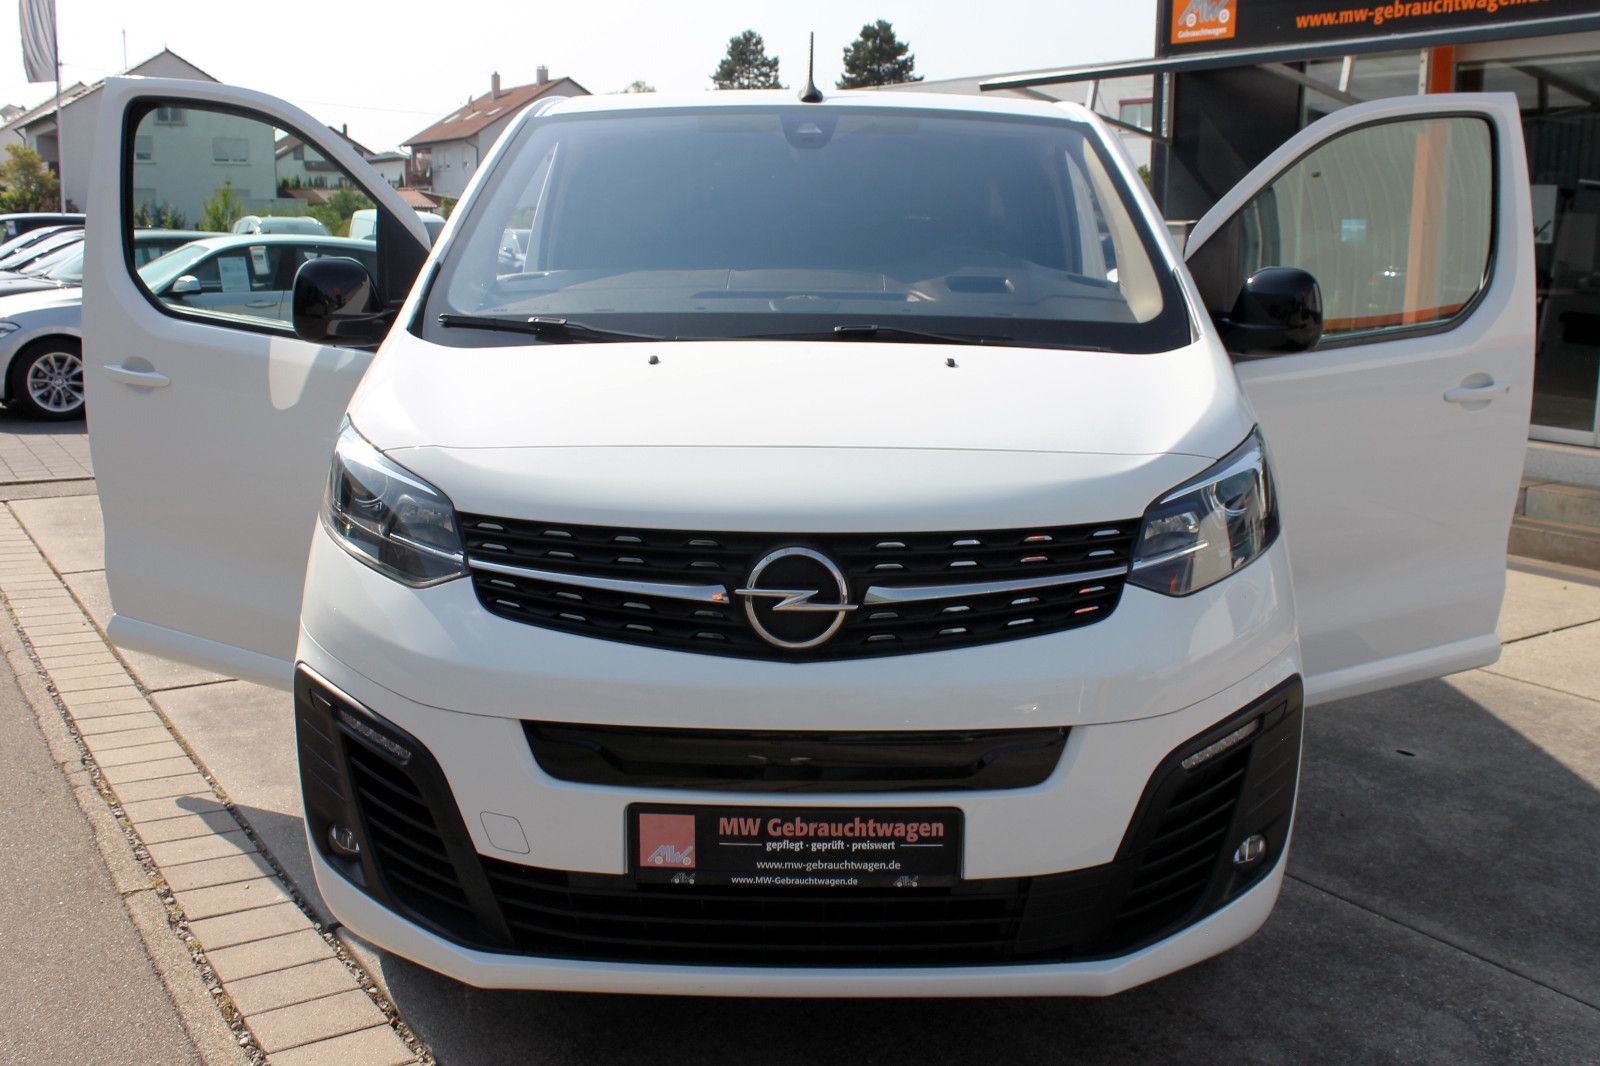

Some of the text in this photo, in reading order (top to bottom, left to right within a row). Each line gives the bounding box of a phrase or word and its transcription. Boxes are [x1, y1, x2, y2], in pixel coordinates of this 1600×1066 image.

[1296, 0, 1546, 29] www.mw-gebrauchtwage.
[719, 817, 944, 842] MW Gebrauchtwagen
[766, 840, 896, 853] gepflegt geprüft preiswert
[756, 859, 901, 872] www.mw-gebrauchtwagen.de
[731, 874, 859, 887] www.MW-Gebrauchtwagen.de
